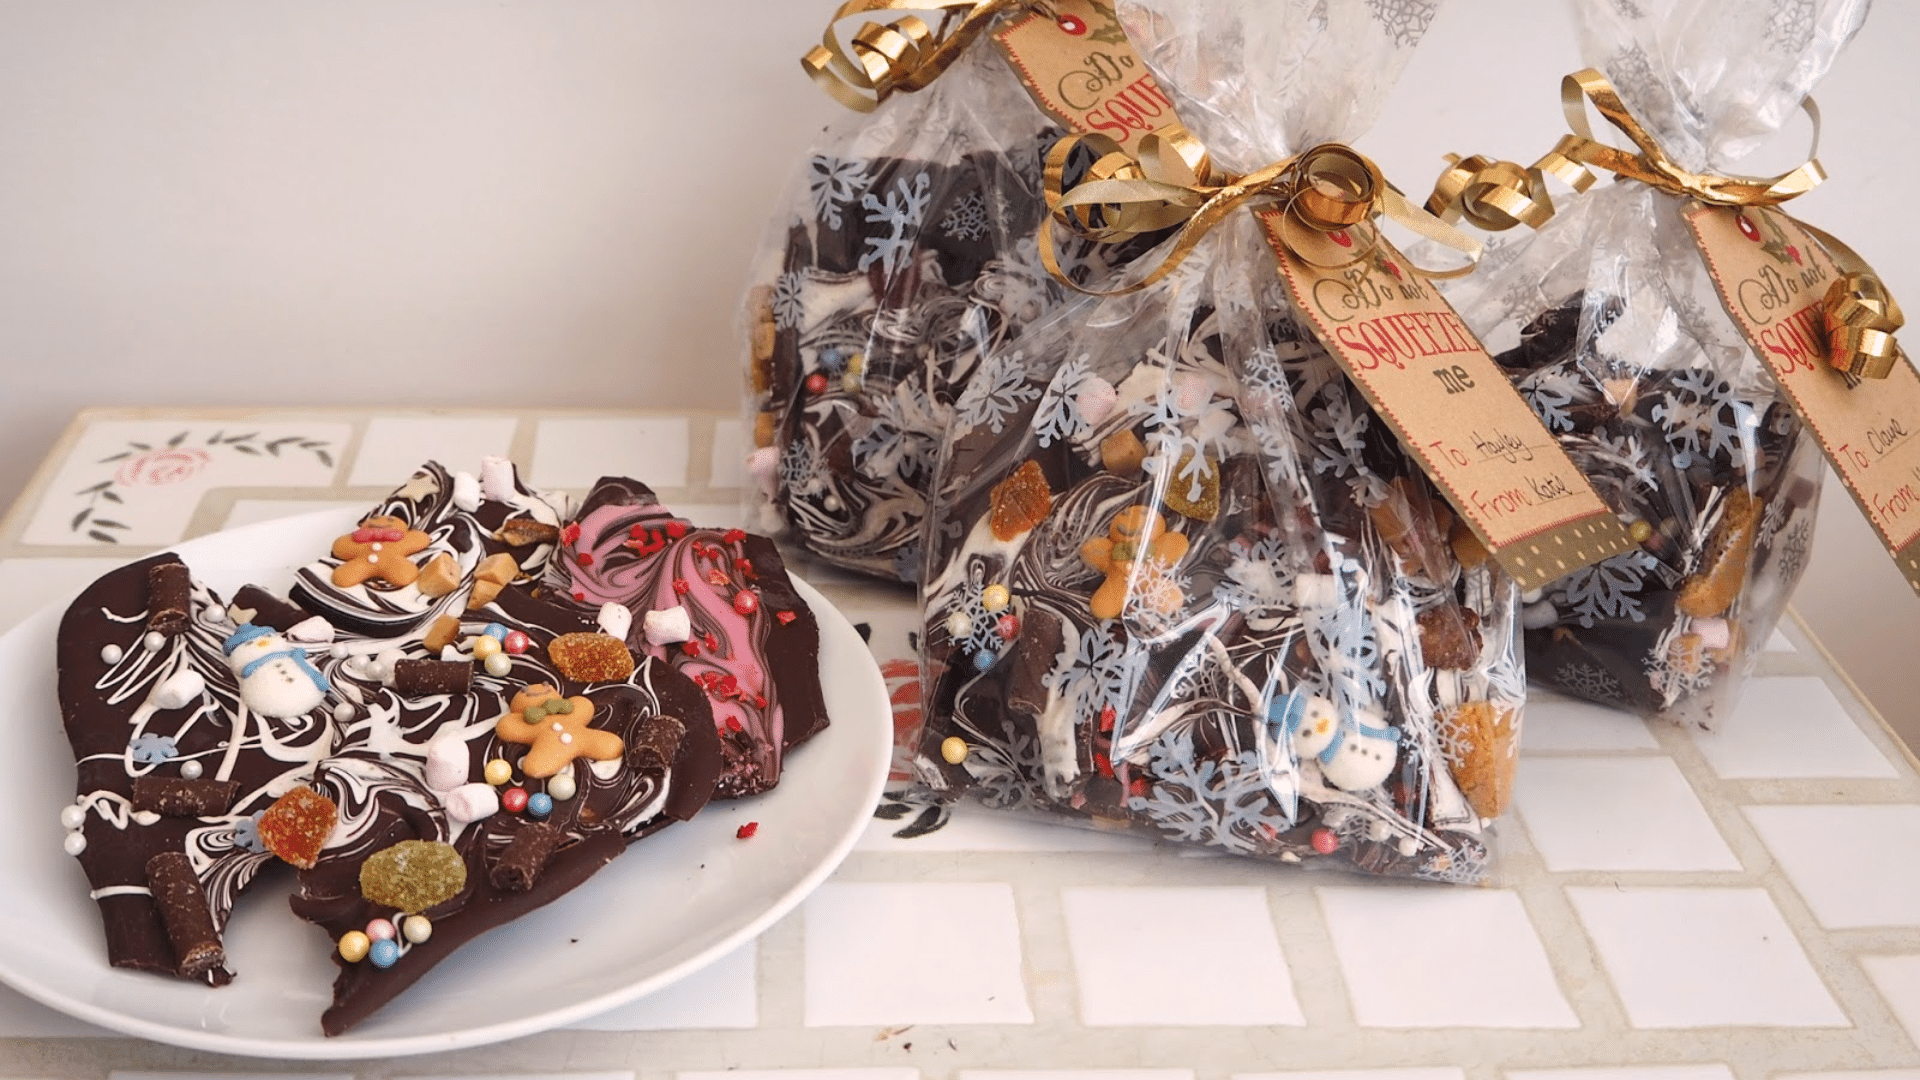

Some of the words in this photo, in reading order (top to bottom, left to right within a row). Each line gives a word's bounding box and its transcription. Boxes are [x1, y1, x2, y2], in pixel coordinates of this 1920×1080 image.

[1058, 51, 1134, 110] Do
[1313, 268, 1393, 322] Do
[1398, 270, 1429, 301] not
[1738, 264, 1798, 325] Do
[1800, 245, 1827, 289] not
[1336, 311, 1481, 370] SQUEEZE
[1433, 365, 1475, 394] me
[1470, 427, 1533, 464] Hayley
[1470, 488, 1532, 521] From
[1872, 484, 1920, 525] From
